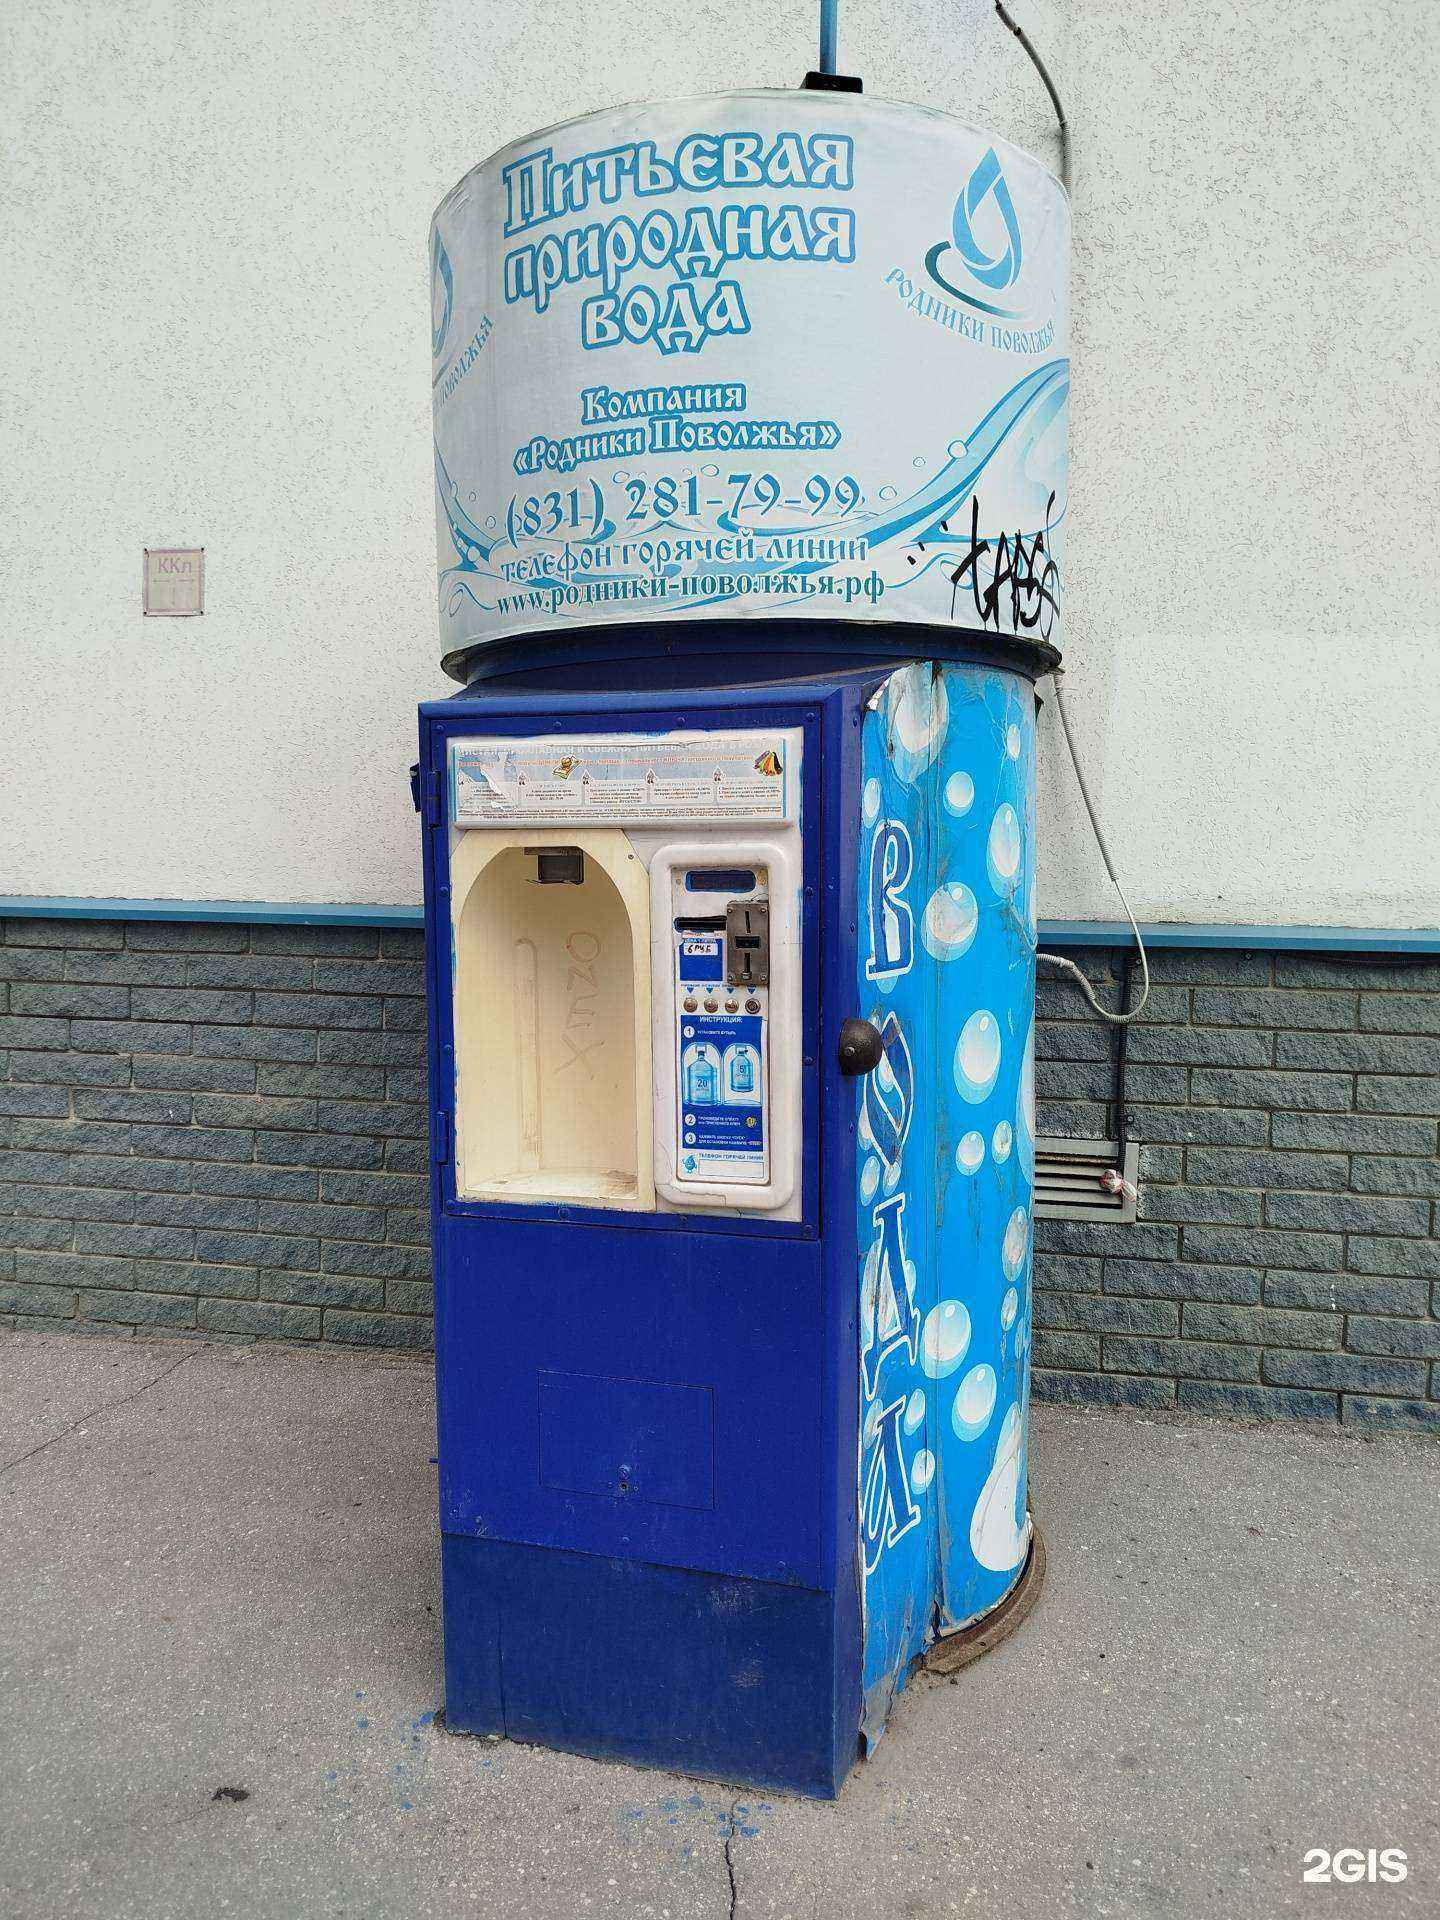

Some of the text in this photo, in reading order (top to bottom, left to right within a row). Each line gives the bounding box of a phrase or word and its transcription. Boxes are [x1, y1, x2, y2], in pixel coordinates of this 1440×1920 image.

[884, 268, 985, 344] РОДНИКИ
[580, 382, 747, 425] Компания
[512, 415, 842, 475] «Родники Поволжья»
[505, 472, 861, 545] (831) 281-79-99
